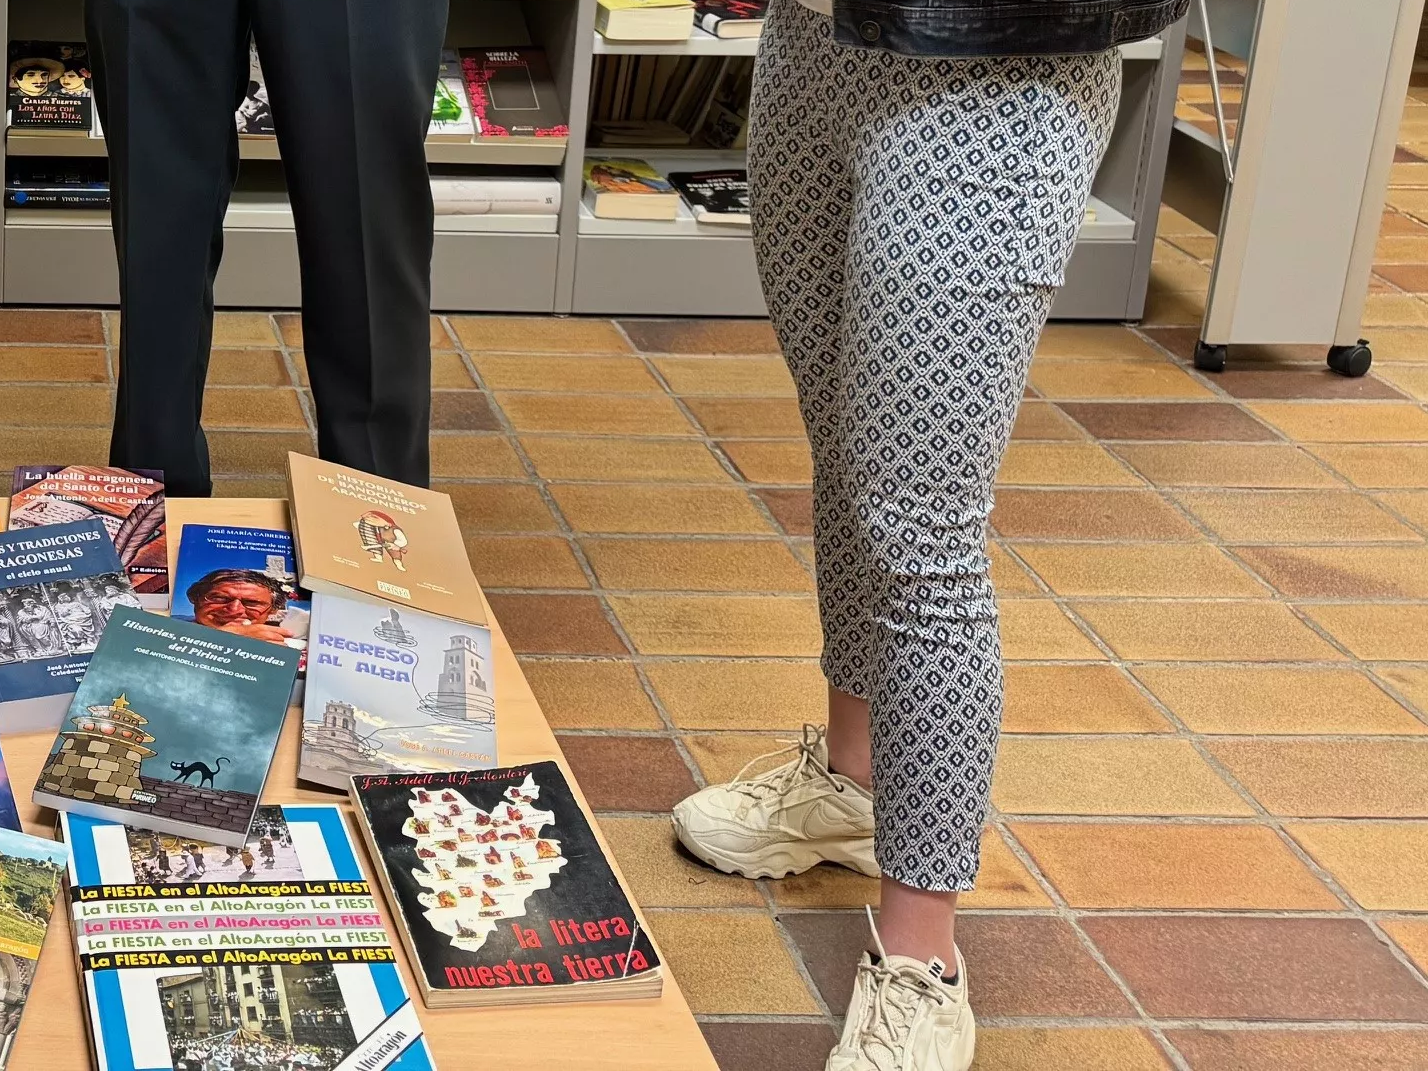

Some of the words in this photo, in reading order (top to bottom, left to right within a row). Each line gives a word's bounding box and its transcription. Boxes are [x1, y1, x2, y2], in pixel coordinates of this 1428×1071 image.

[25, 472, 42, 480] La
[46, 471, 85, 481] huella
[89, 474, 154, 485] aragonesa
[40, 482, 59, 490] del
[62, 483, 100, 492] Santo
[104, 484, 138, 494] Grial
[336, 472, 405, 498] HISTORIAS
[317, 474, 335, 485] DE
[338, 479, 428, 511] BANDOLEROS
[330, 486, 417, 515] ARAGONESES
[5, 542, 17, 553] Y
[17, 530, 101, 551] TRADICIONES
[226, 529, 252, 537] MARÍA
[253, 532, 290, 540] CABRERO
[6, 572, 15, 580] el
[17, 569, 42, 579] ciclo
[43, 564, 72, 575] anual
[123, 619, 177, 640] Historias,
[180, 634, 224, 652] cuentos
[226, 645, 233, 656] y
[235, 647, 286, 667] leyendas
[168, 642, 185, 653] del
[188, 647, 231, 665] Pirineo
[318, 633, 415, 666] REGRESO
[317, 653, 343, 668] AL
[354, 661, 411, 684] ALBA
[79, 886, 100, 899] La
[102, 884, 154, 898] FIESTA
[161, 886, 182, 896] en
[186, 883, 201, 895] el
[206, 881, 300, 897] AltoAragón
[305, 882, 324, 894] La
[83, 920, 104, 934] La
[108, 918, 162, 932] FIESTA
[168, 920, 189, 930] en
[194, 916, 209, 929] el
[214, 915, 312, 930] AltoAragón
[316, 915, 336, 927] La
[511, 923, 543, 950] la
[550, 914, 631, 947] litera
[89, 955, 110, 969] La
[114, 952, 171, 966] FIESTA
[174, 954, 197, 965] en
[202, 950, 218, 964] el
[222, 949, 324, 964] AltoAragón
[327, 948, 349, 961] La
[444, 958, 554, 988] nuestra
[562, 949, 650, 981] tierra
